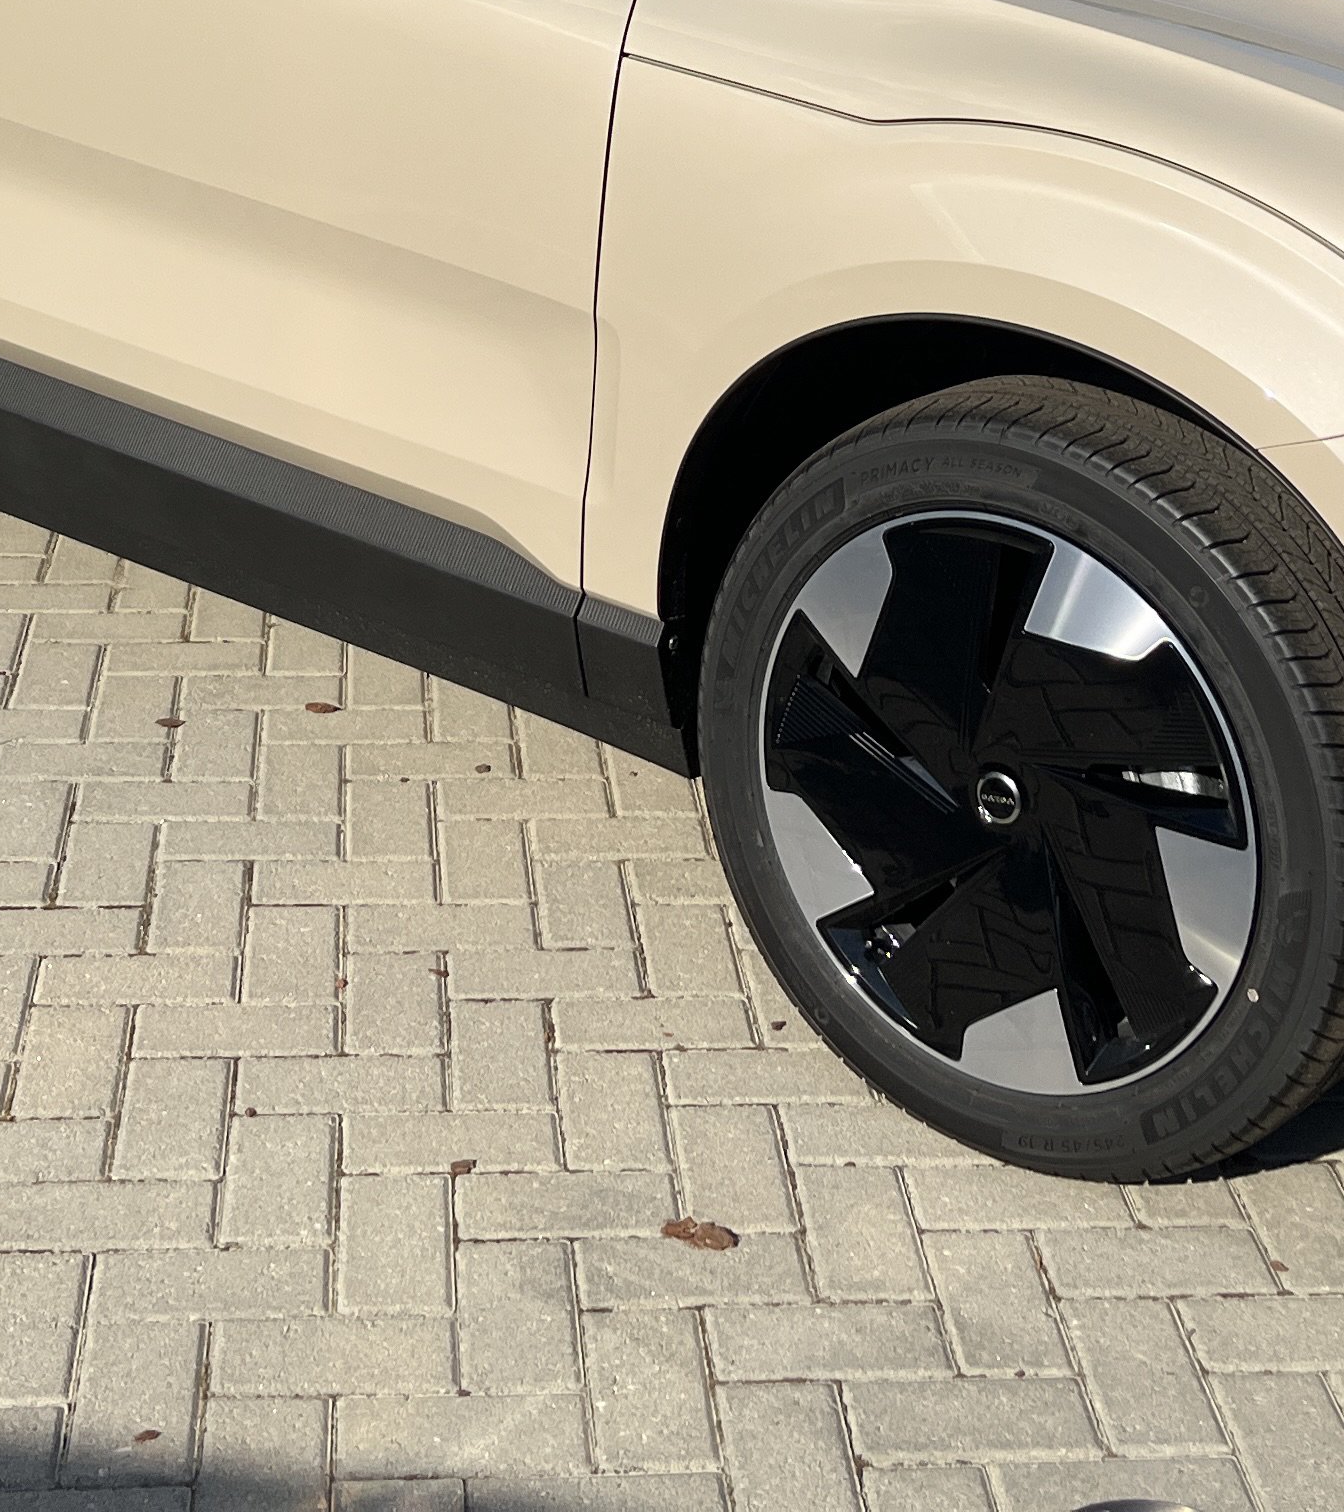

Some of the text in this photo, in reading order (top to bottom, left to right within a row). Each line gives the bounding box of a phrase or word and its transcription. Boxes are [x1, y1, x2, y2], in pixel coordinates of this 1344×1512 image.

[859, 456, 1023, 486] PRIMACY ALL SEASON
[720, 487, 836, 667] MICHELIN
